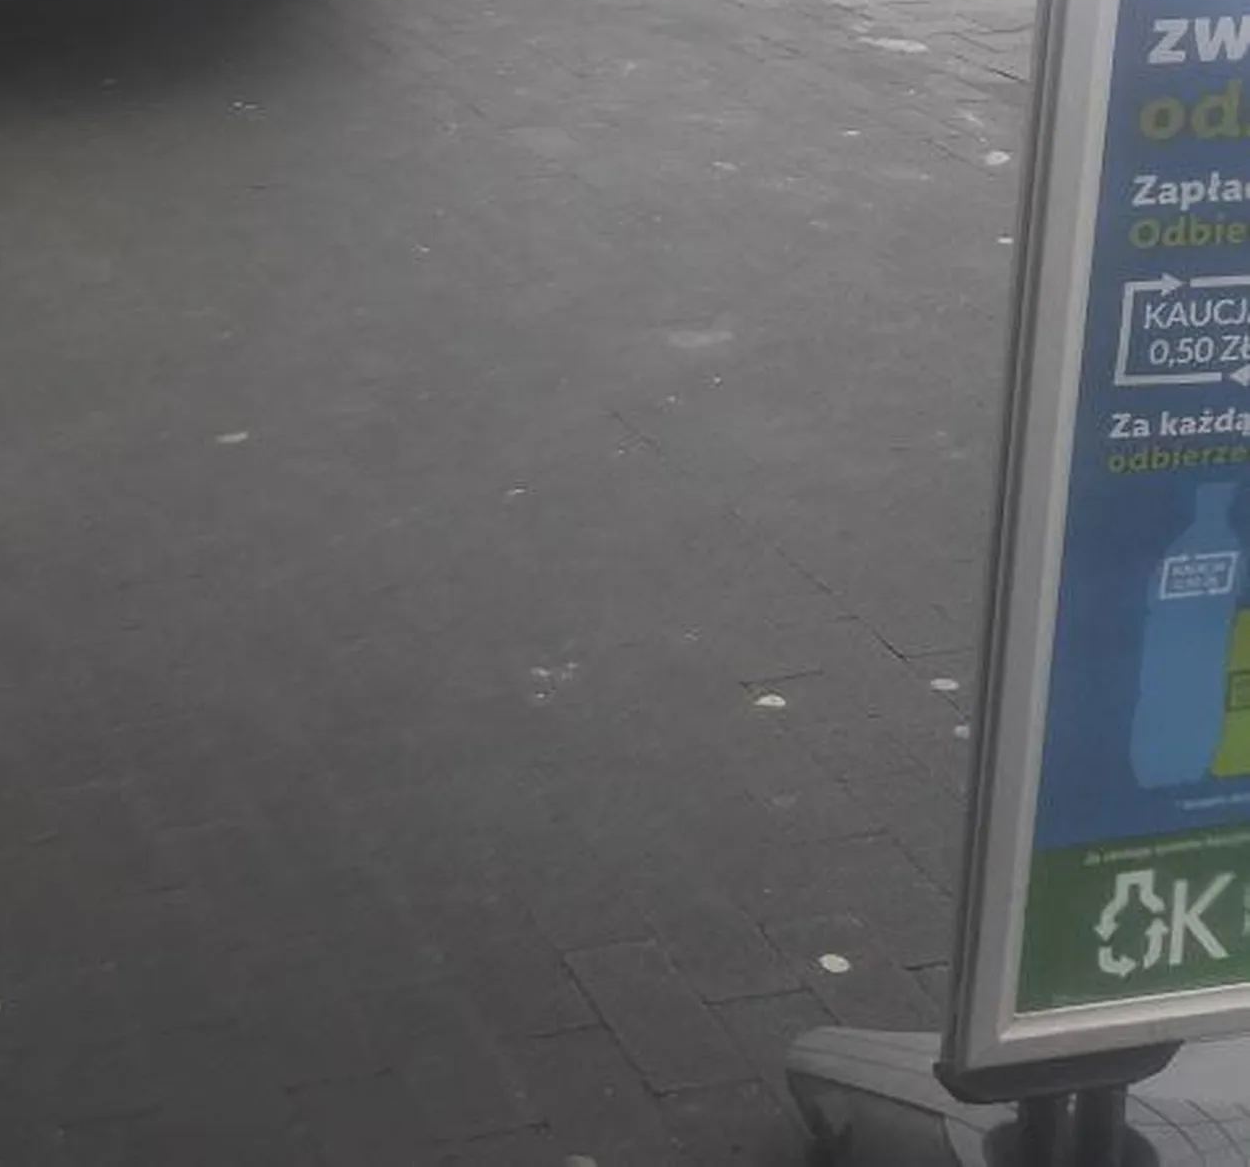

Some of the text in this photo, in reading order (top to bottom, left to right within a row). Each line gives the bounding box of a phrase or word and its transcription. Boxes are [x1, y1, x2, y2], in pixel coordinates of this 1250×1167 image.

[1147, 15, 1250, 64] zw
[1139, 79, 1250, 140] od
[1143, 297, 1250, 330] KAUCJ
[1149, 336, 1215, 368] 0,50
[1108, 412, 1151, 438] Za
